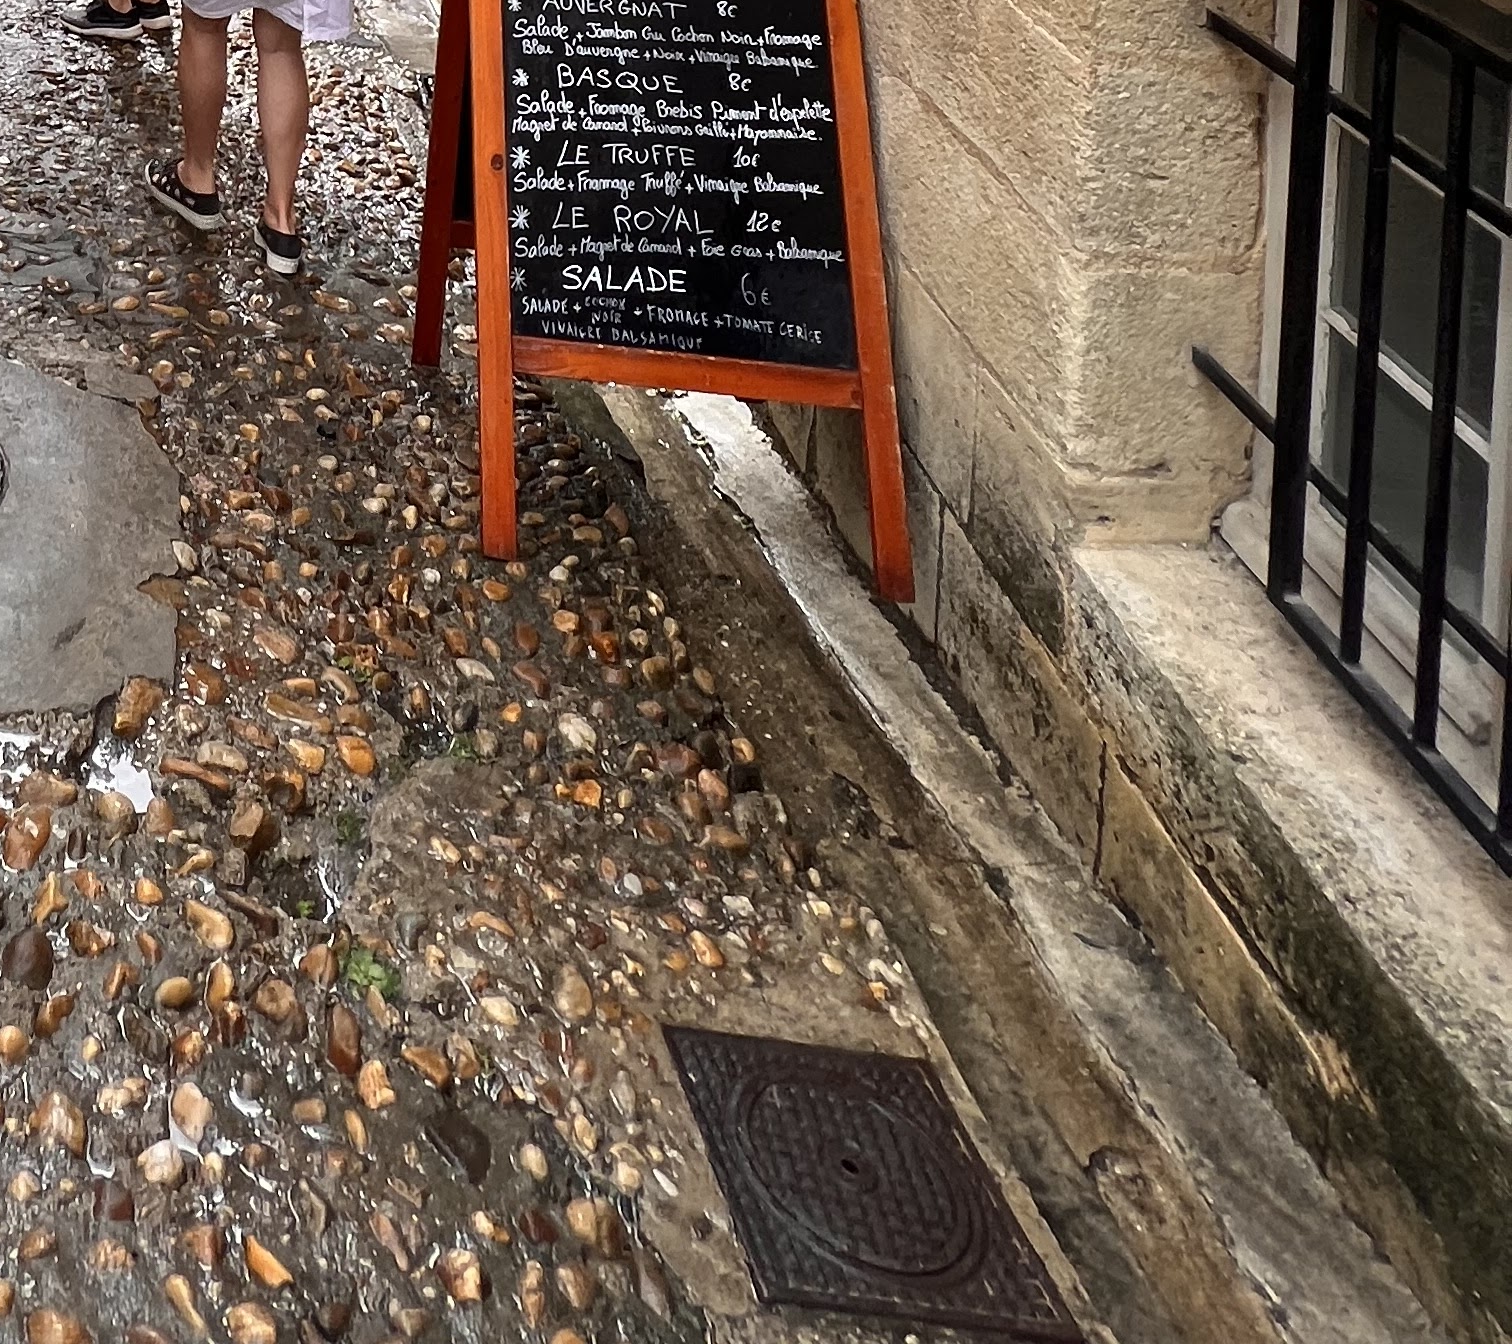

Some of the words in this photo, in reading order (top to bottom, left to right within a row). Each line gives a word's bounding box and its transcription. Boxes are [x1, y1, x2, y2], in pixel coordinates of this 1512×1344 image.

[513, 13, 569, 40] Salade
[586, 20, 638, 40] Jambon
[556, 62, 684, 95] BASQUE
[516, 89, 575, 115] Salade
[588, 93, 646, 128] Fromage
[561, 113, 578, 132] de
[556, 139, 591, 168] LE
[601, 143, 697, 168] TRUFFE
[513, 165, 566, 193] Salade
[551, 200, 590, 230] LE
[612, 204, 715, 236] ROYAL
[514, 233, 564, 259] Salade
[620, 233, 635, 253] de
[562, 263, 687, 294] SALADE
[522, 295, 569, 315] SALADE
[646, 303, 709, 328] FROMAGE
